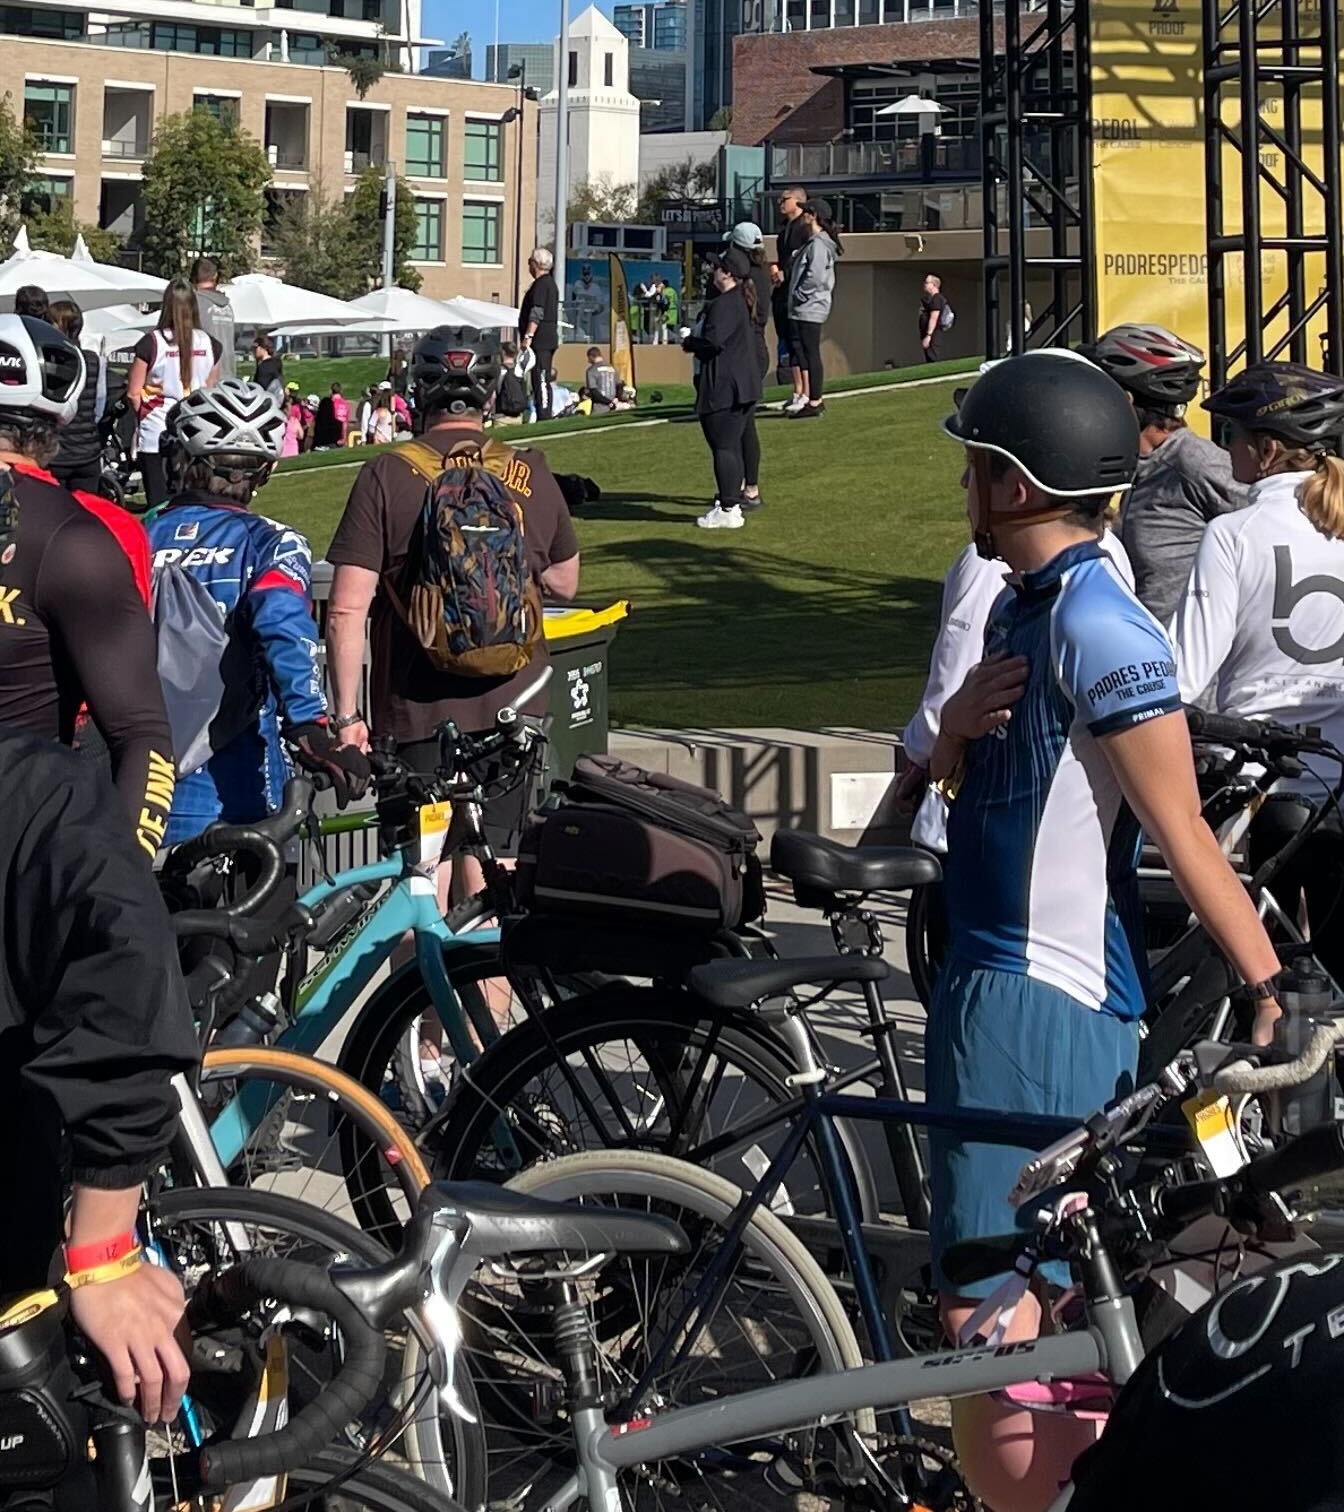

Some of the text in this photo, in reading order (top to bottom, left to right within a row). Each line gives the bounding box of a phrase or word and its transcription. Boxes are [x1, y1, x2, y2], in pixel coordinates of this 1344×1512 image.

[1149, 21, 1185, 36] PROOF
[1105, 254, 1208, 276] PADRESPEDA
[153, 547, 235, 568] REK
[1087, 660, 1177, 707] PADRES PED
[1115, 678, 1167, 701] THE CAUSE
[0, 1434, 24, 1451] UP
